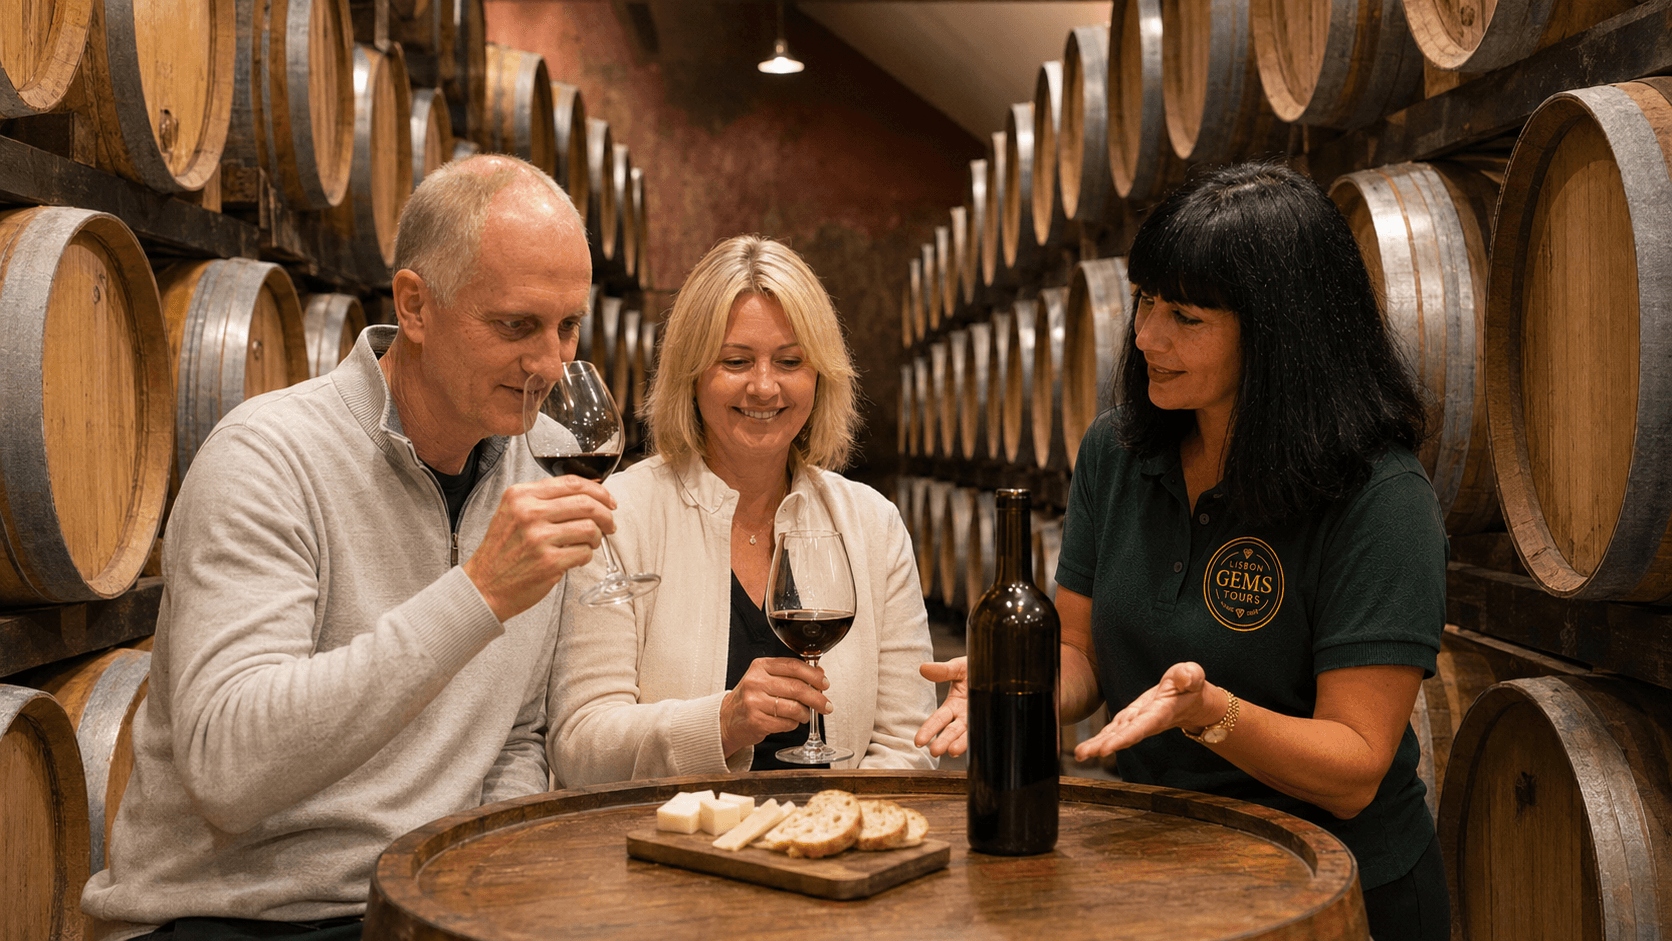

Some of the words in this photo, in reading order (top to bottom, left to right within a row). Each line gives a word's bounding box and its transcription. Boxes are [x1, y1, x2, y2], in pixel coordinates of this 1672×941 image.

[1229, 560, 1264, 572] LISBON
[1216, 569, 1273, 594] GEMS
[1223, 589, 1260, 605] TOURS
